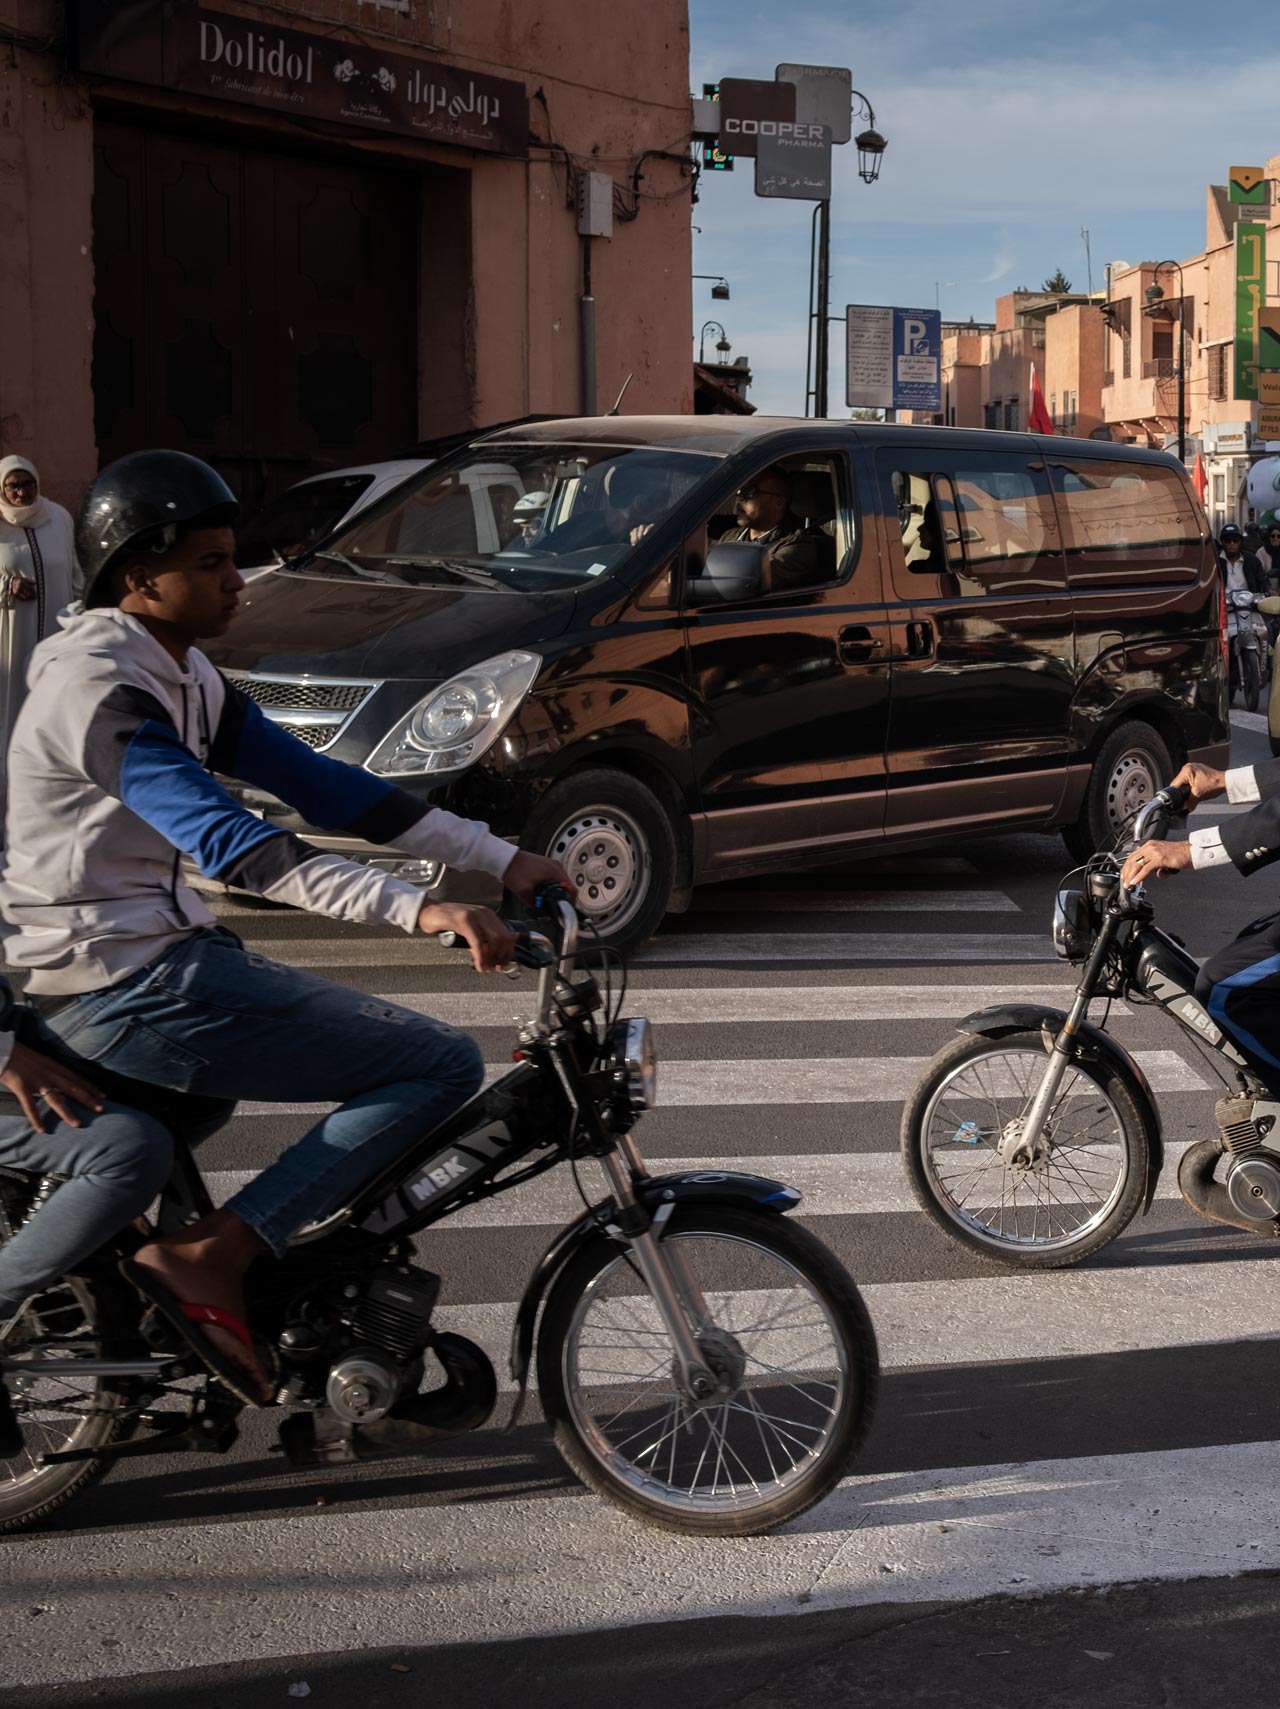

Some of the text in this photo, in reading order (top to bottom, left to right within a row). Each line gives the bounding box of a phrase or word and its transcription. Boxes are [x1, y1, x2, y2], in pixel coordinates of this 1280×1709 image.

[199, 20, 313, 83] Dolidol
[725, 118, 824, 140] COOPER
[778, 138, 825, 149] PHARMA
[904, 320, 927, 355] P
[1181, 1002, 1219, 1039] MBK
[409, 1155, 469, 1201] MBK
